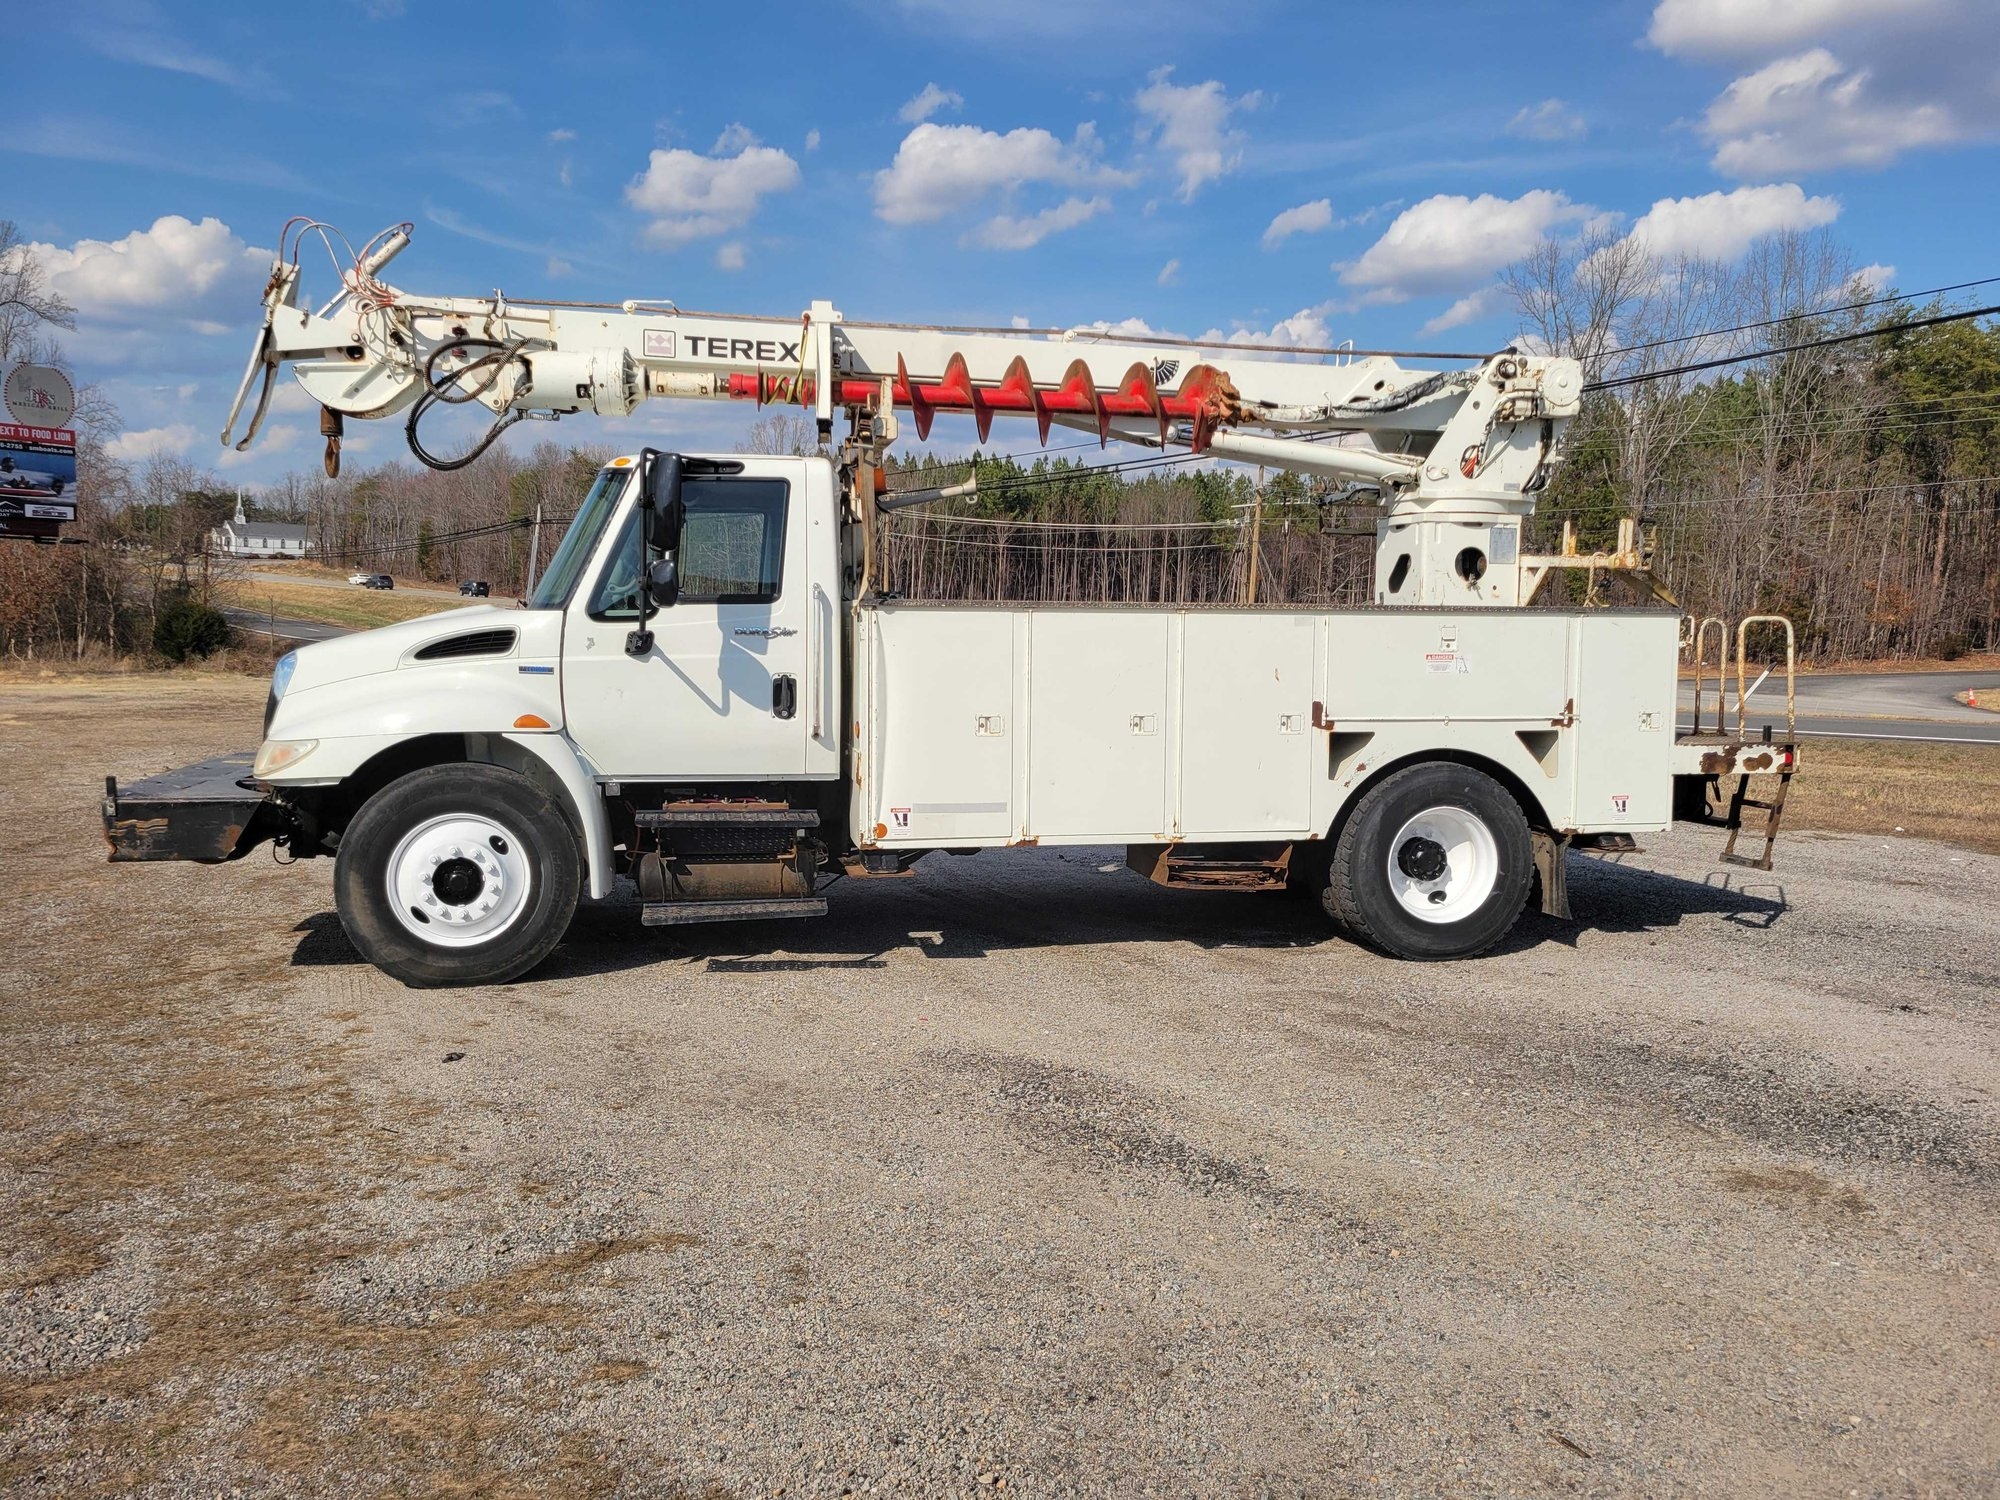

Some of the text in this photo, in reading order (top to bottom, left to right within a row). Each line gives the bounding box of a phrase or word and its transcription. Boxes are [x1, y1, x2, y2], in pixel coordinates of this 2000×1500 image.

[684, 335, 801, 363] TEREX
[0, 425, 71, 441] EXT TO FOOD LION
[29, 446, 74, 454] smboats.com
